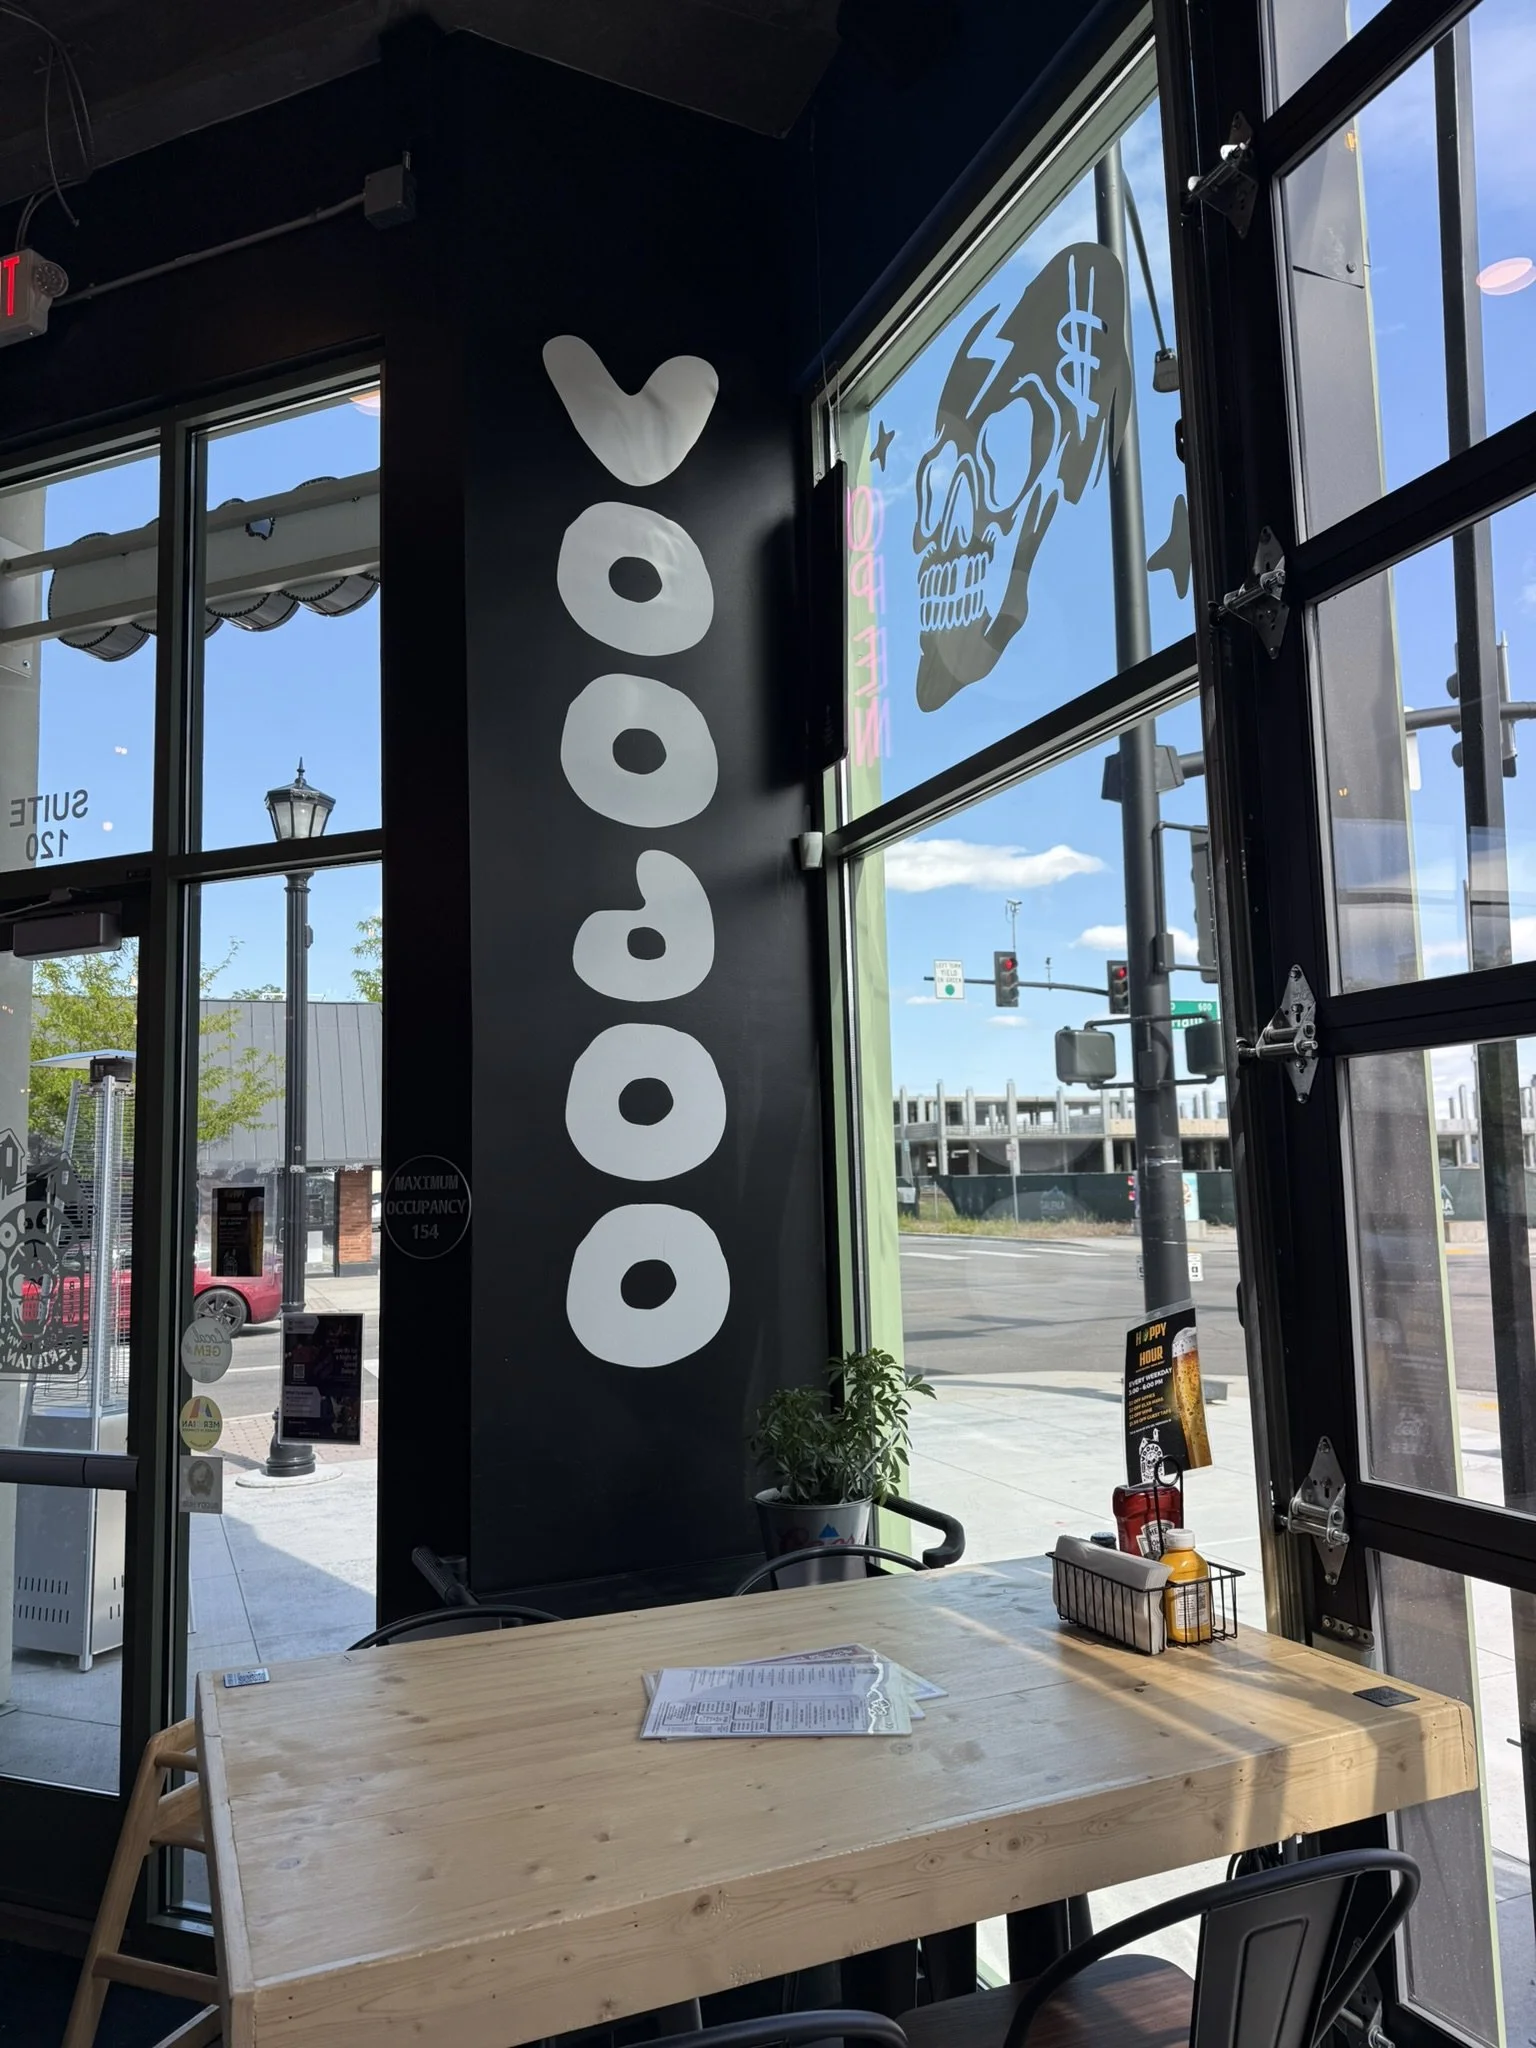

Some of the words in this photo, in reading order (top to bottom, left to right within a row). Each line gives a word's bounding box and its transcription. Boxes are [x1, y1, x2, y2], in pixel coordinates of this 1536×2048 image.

[394, 1174, 459, 1191] MAXIMUM
[386, 1199, 467, 1215] OCCUPANCY
[411, 1223, 439, 1240] 154
[1139, 1345, 1164, 1367] HOUR
[1128, 1377, 1145, 1388] EVERY
[1145, 1367, 1173, 1382] WEEKDAY
[1155, 1378, 1164, 1387] PM
